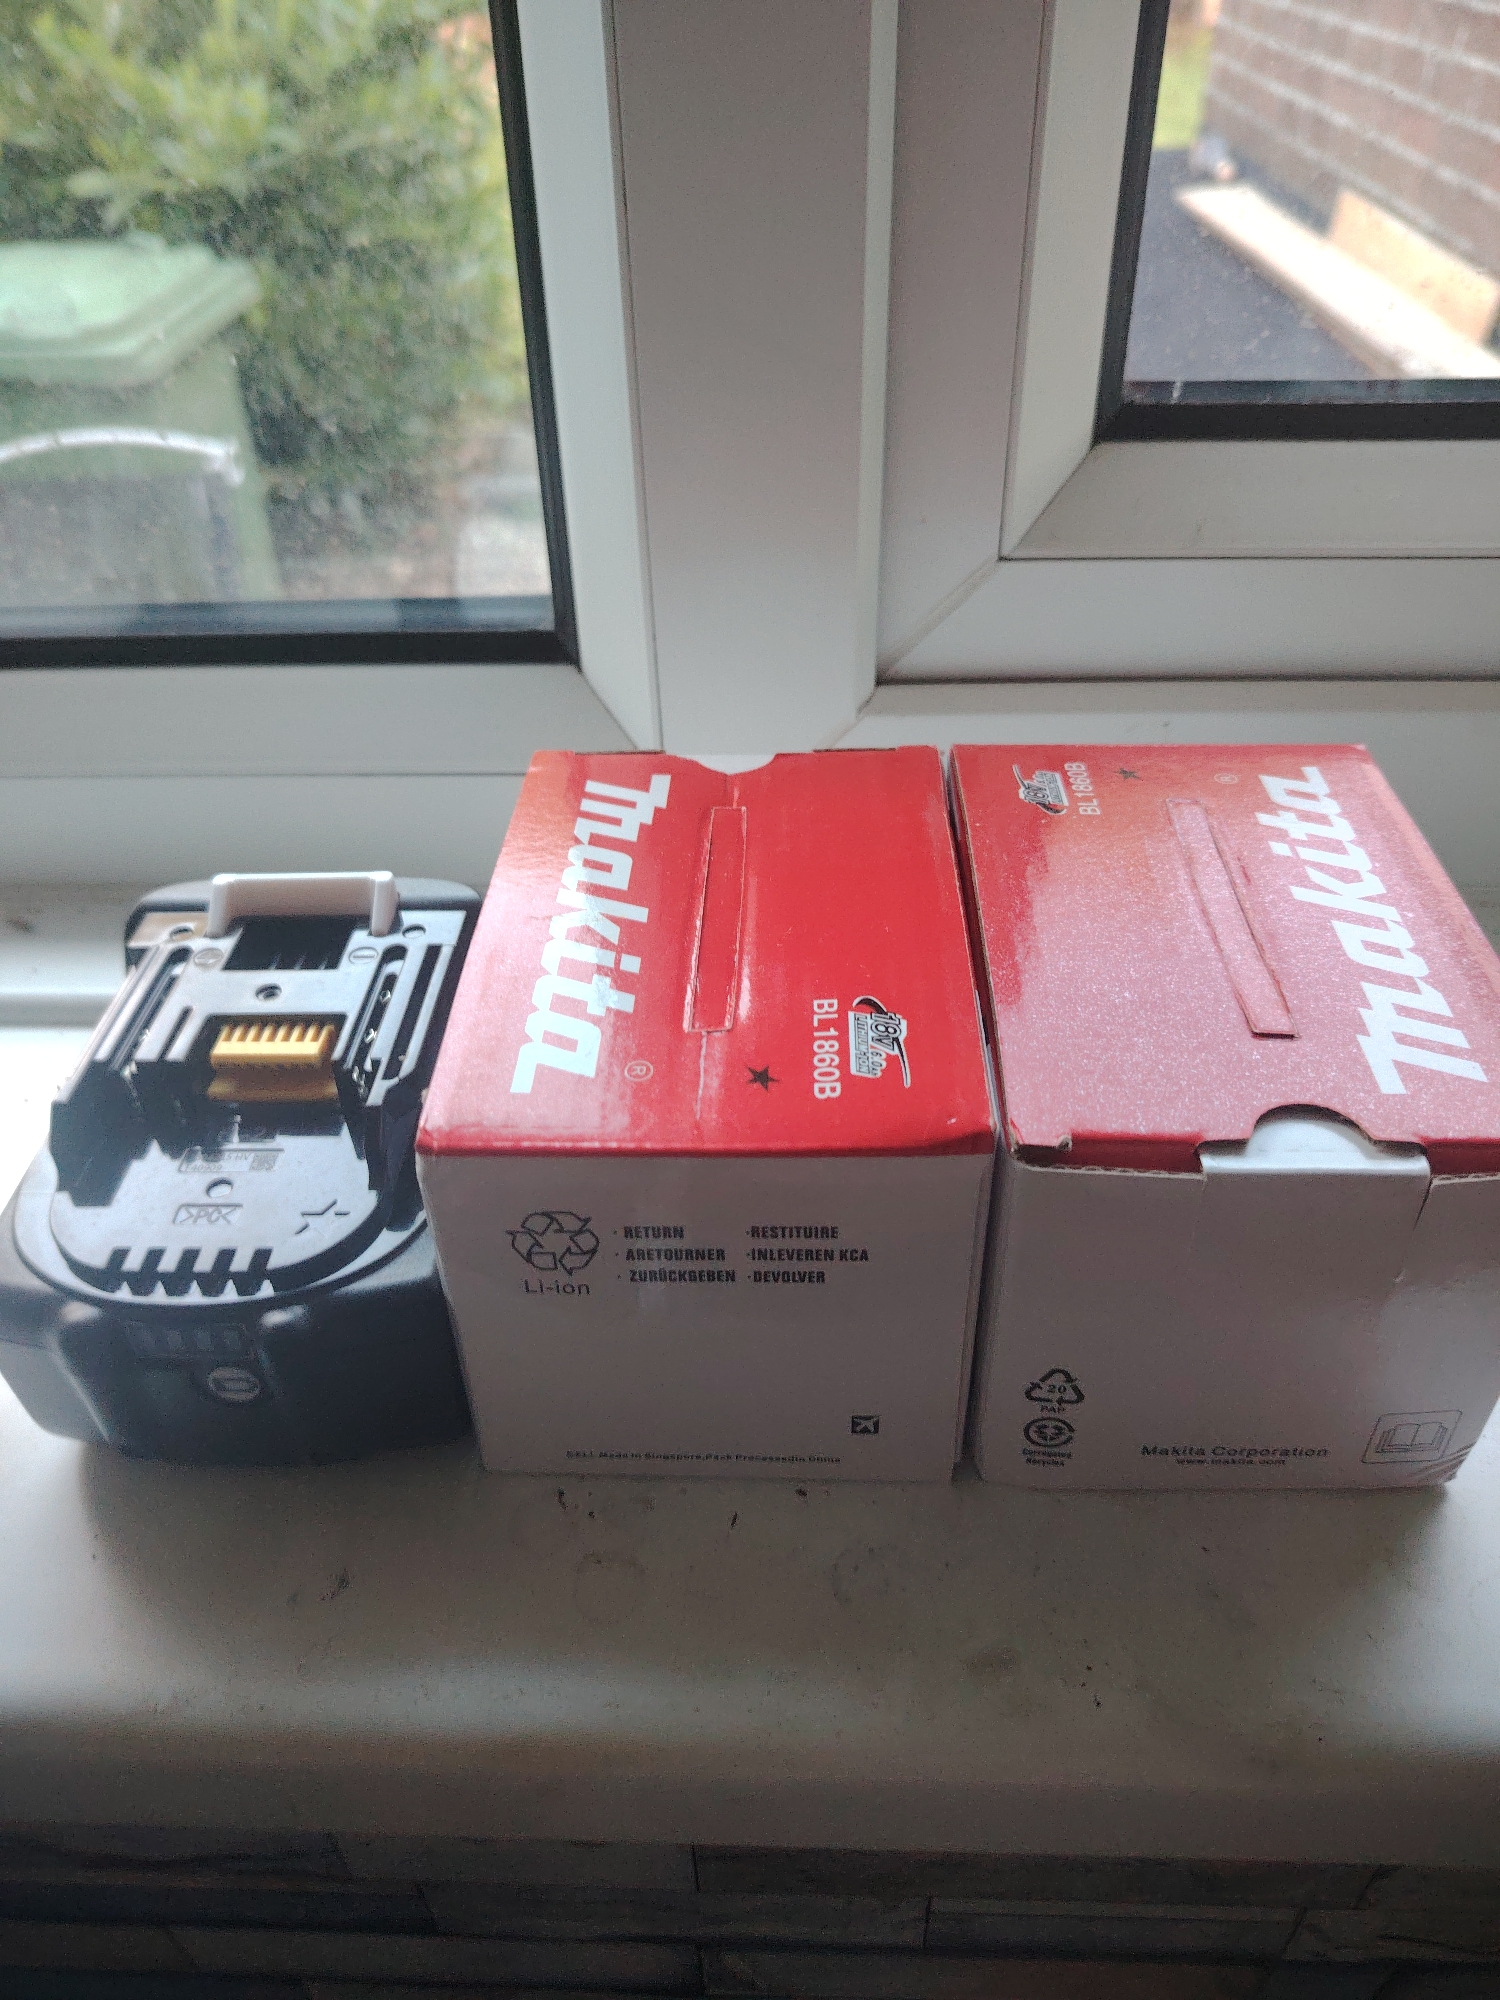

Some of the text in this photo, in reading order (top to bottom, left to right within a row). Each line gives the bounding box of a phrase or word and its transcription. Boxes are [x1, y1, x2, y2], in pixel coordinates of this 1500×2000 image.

[869, 1011, 902, 1052] 18V
[812, 998, 842, 1100] BL1860B
[623, 1225, 685, 1240] RETURN
[750, 1225, 839, 1240] RESTITUIRE
[751, 1248, 835, 1262] INLEVEREN
[752, 1269, 827, 1284] DEVOLVER
[523, 1278, 592, 1297] Li-ion
[1047, 1383, 1068, 1395] 20
[1140, 1443, 1331, 1459] Makita Corporation
